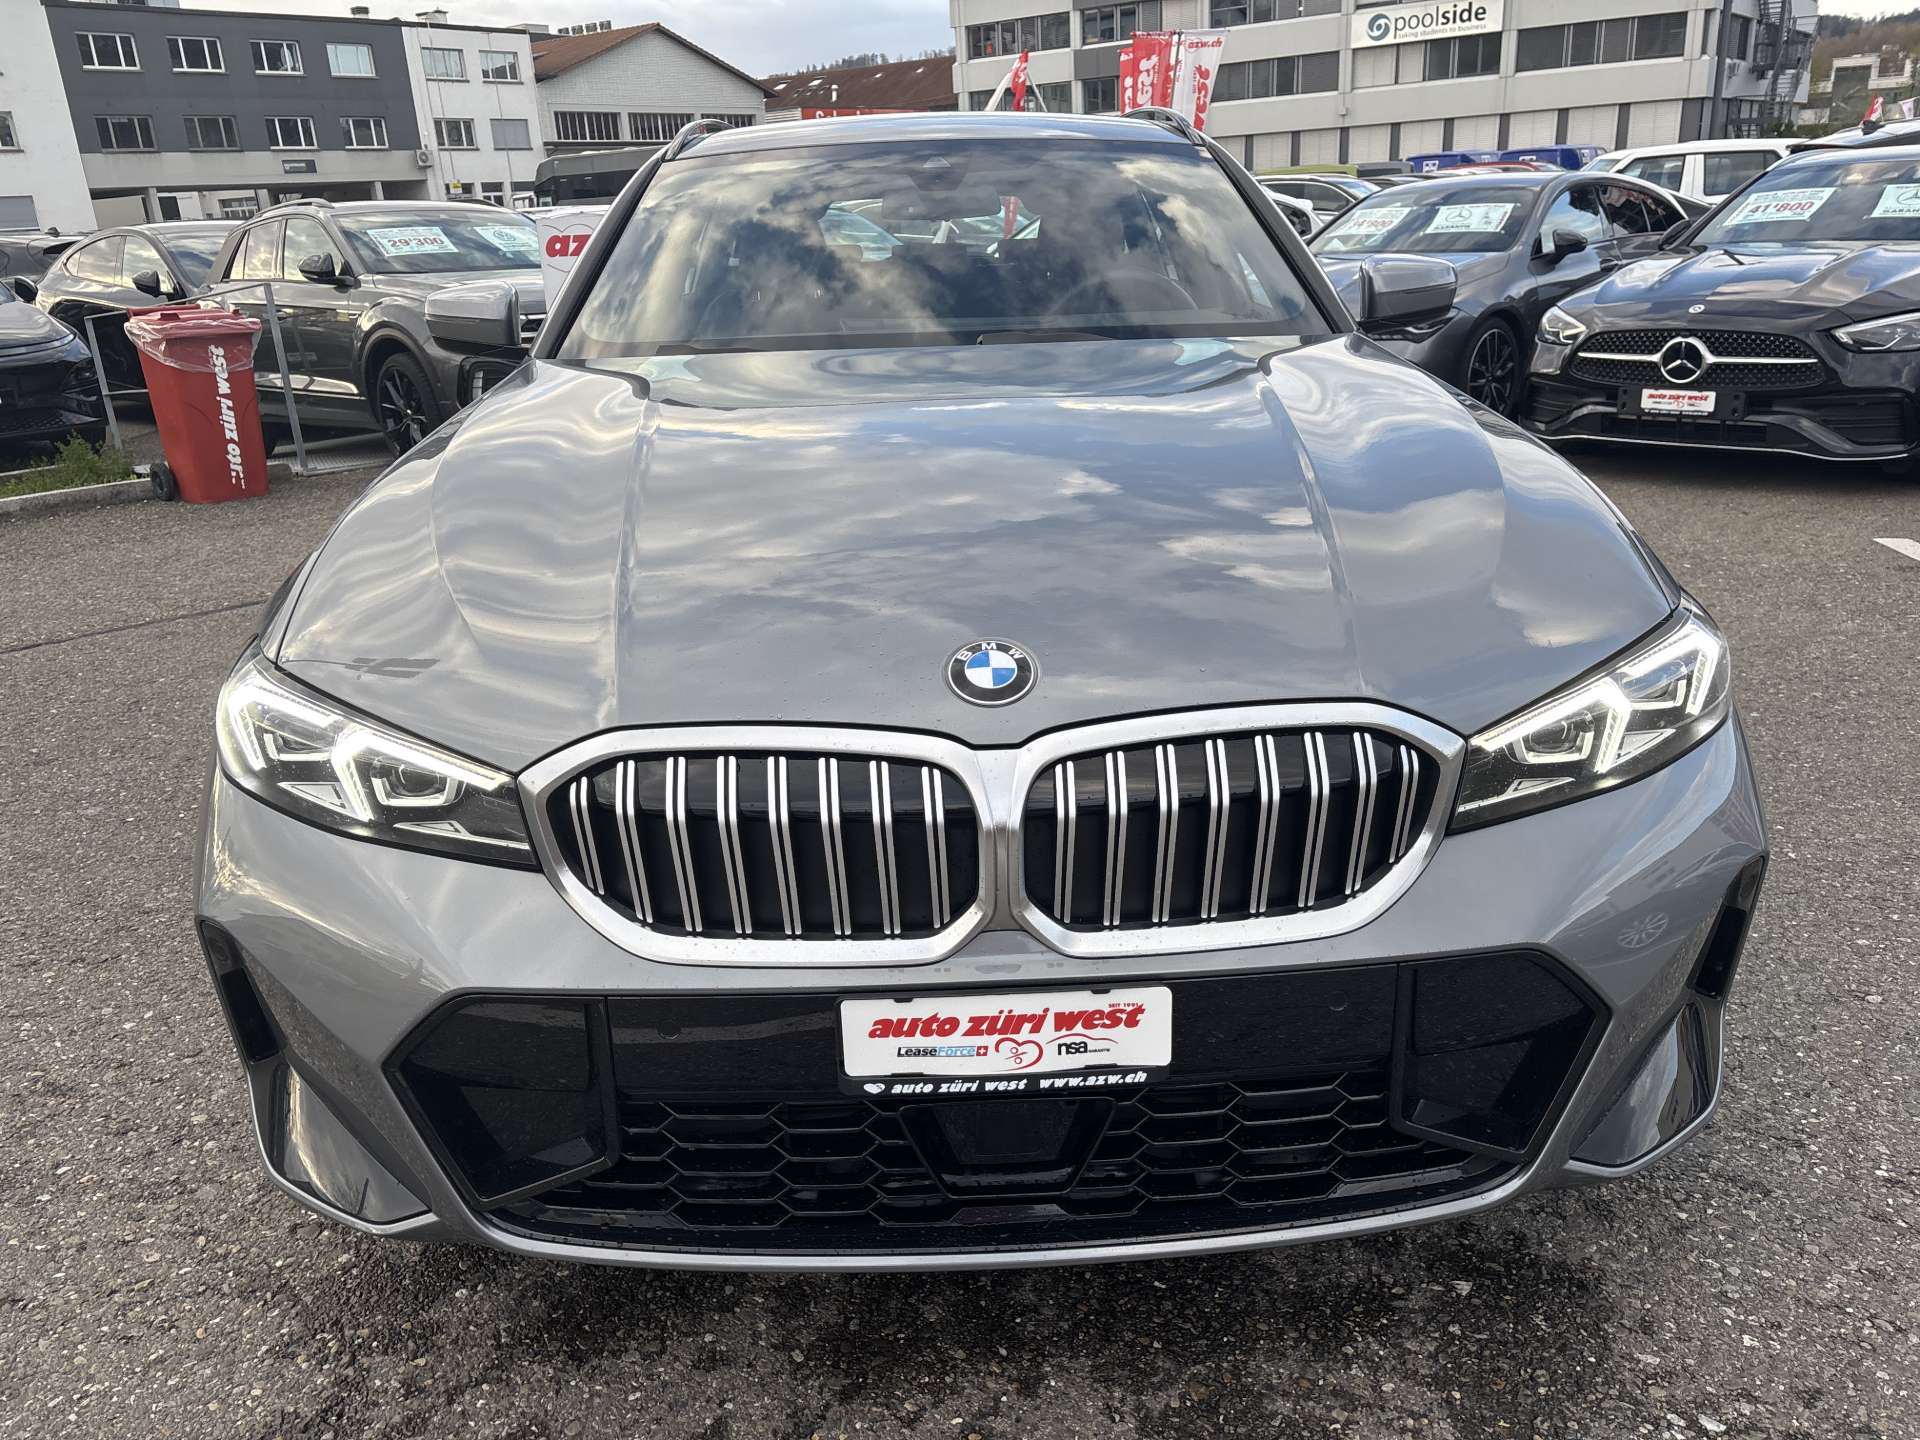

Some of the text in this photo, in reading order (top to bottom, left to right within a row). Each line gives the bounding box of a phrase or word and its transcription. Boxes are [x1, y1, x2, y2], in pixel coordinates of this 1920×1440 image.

[1393, 2, 1487, 39] poolside
[1420, 28, 1448, 37] students
[1457, 24, 1487, 32] business
[1187, 37, 1222, 49] azw.ch
[1748, 201, 1815, 213] 41'800
[387, 237, 444, 248] 29'300
[210, 344, 231, 394] west
[216, 396, 239, 443] züri
[957, 642, 1024, 661] BMW
[868, 1003, 1145, 1038] auto züri west
[897, 1046, 976, 1057] LeaseForce
[1058, 1041, 1088, 1055] nsa
[891, 1071, 1147, 1094] auto züri west www.azw.ch
